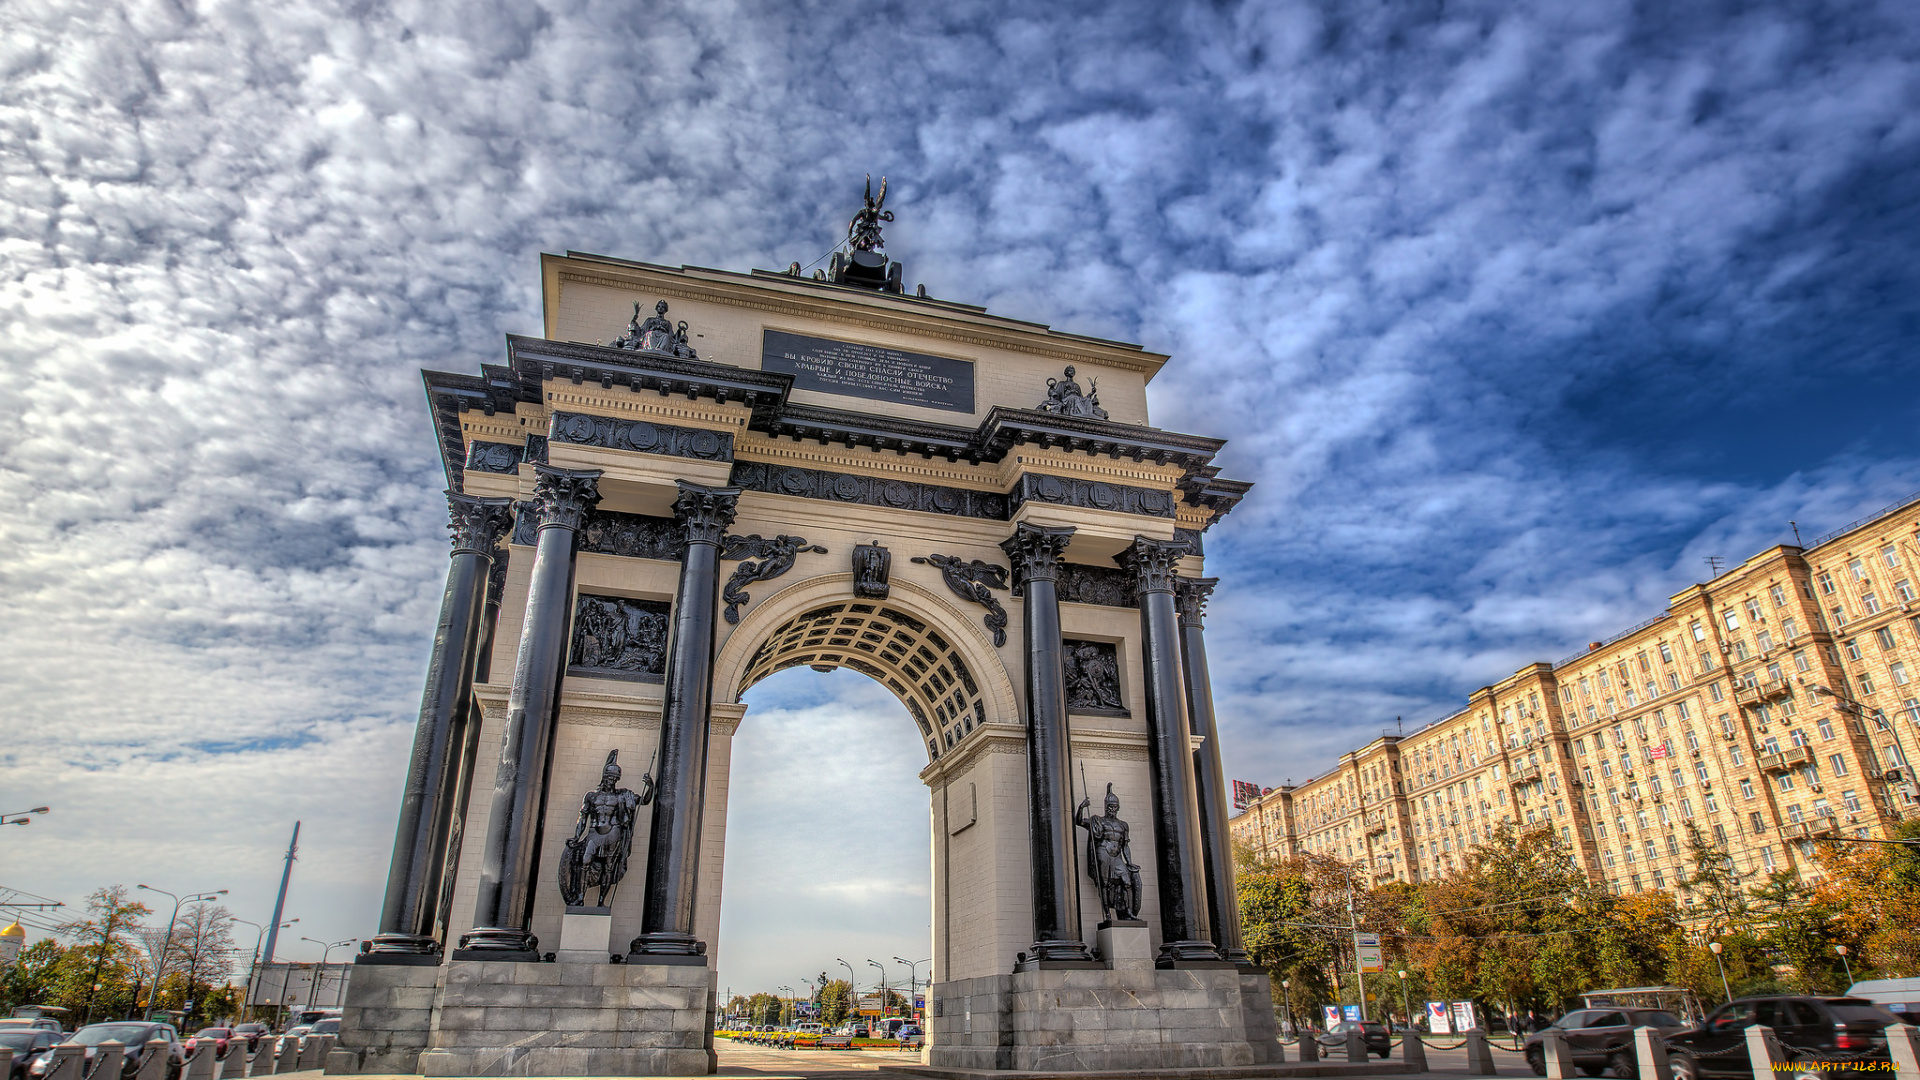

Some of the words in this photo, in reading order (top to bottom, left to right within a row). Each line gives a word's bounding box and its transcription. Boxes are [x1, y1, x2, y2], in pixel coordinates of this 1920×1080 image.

[794, 361, 830, 373] ХРАБРЫЕ
[845, 369, 912, 385] ПОБЕДОНОСНЫЕ
[915, 380, 947, 390] ВОЙСКА
[800, 354, 833, 365] КРОВИЮ
[836, 360, 866, 371] СВОЕЮ
[869, 365, 902, 376] СПАСЛИ
[906, 371, 953, 384] ОТЕЧЕСТВО
